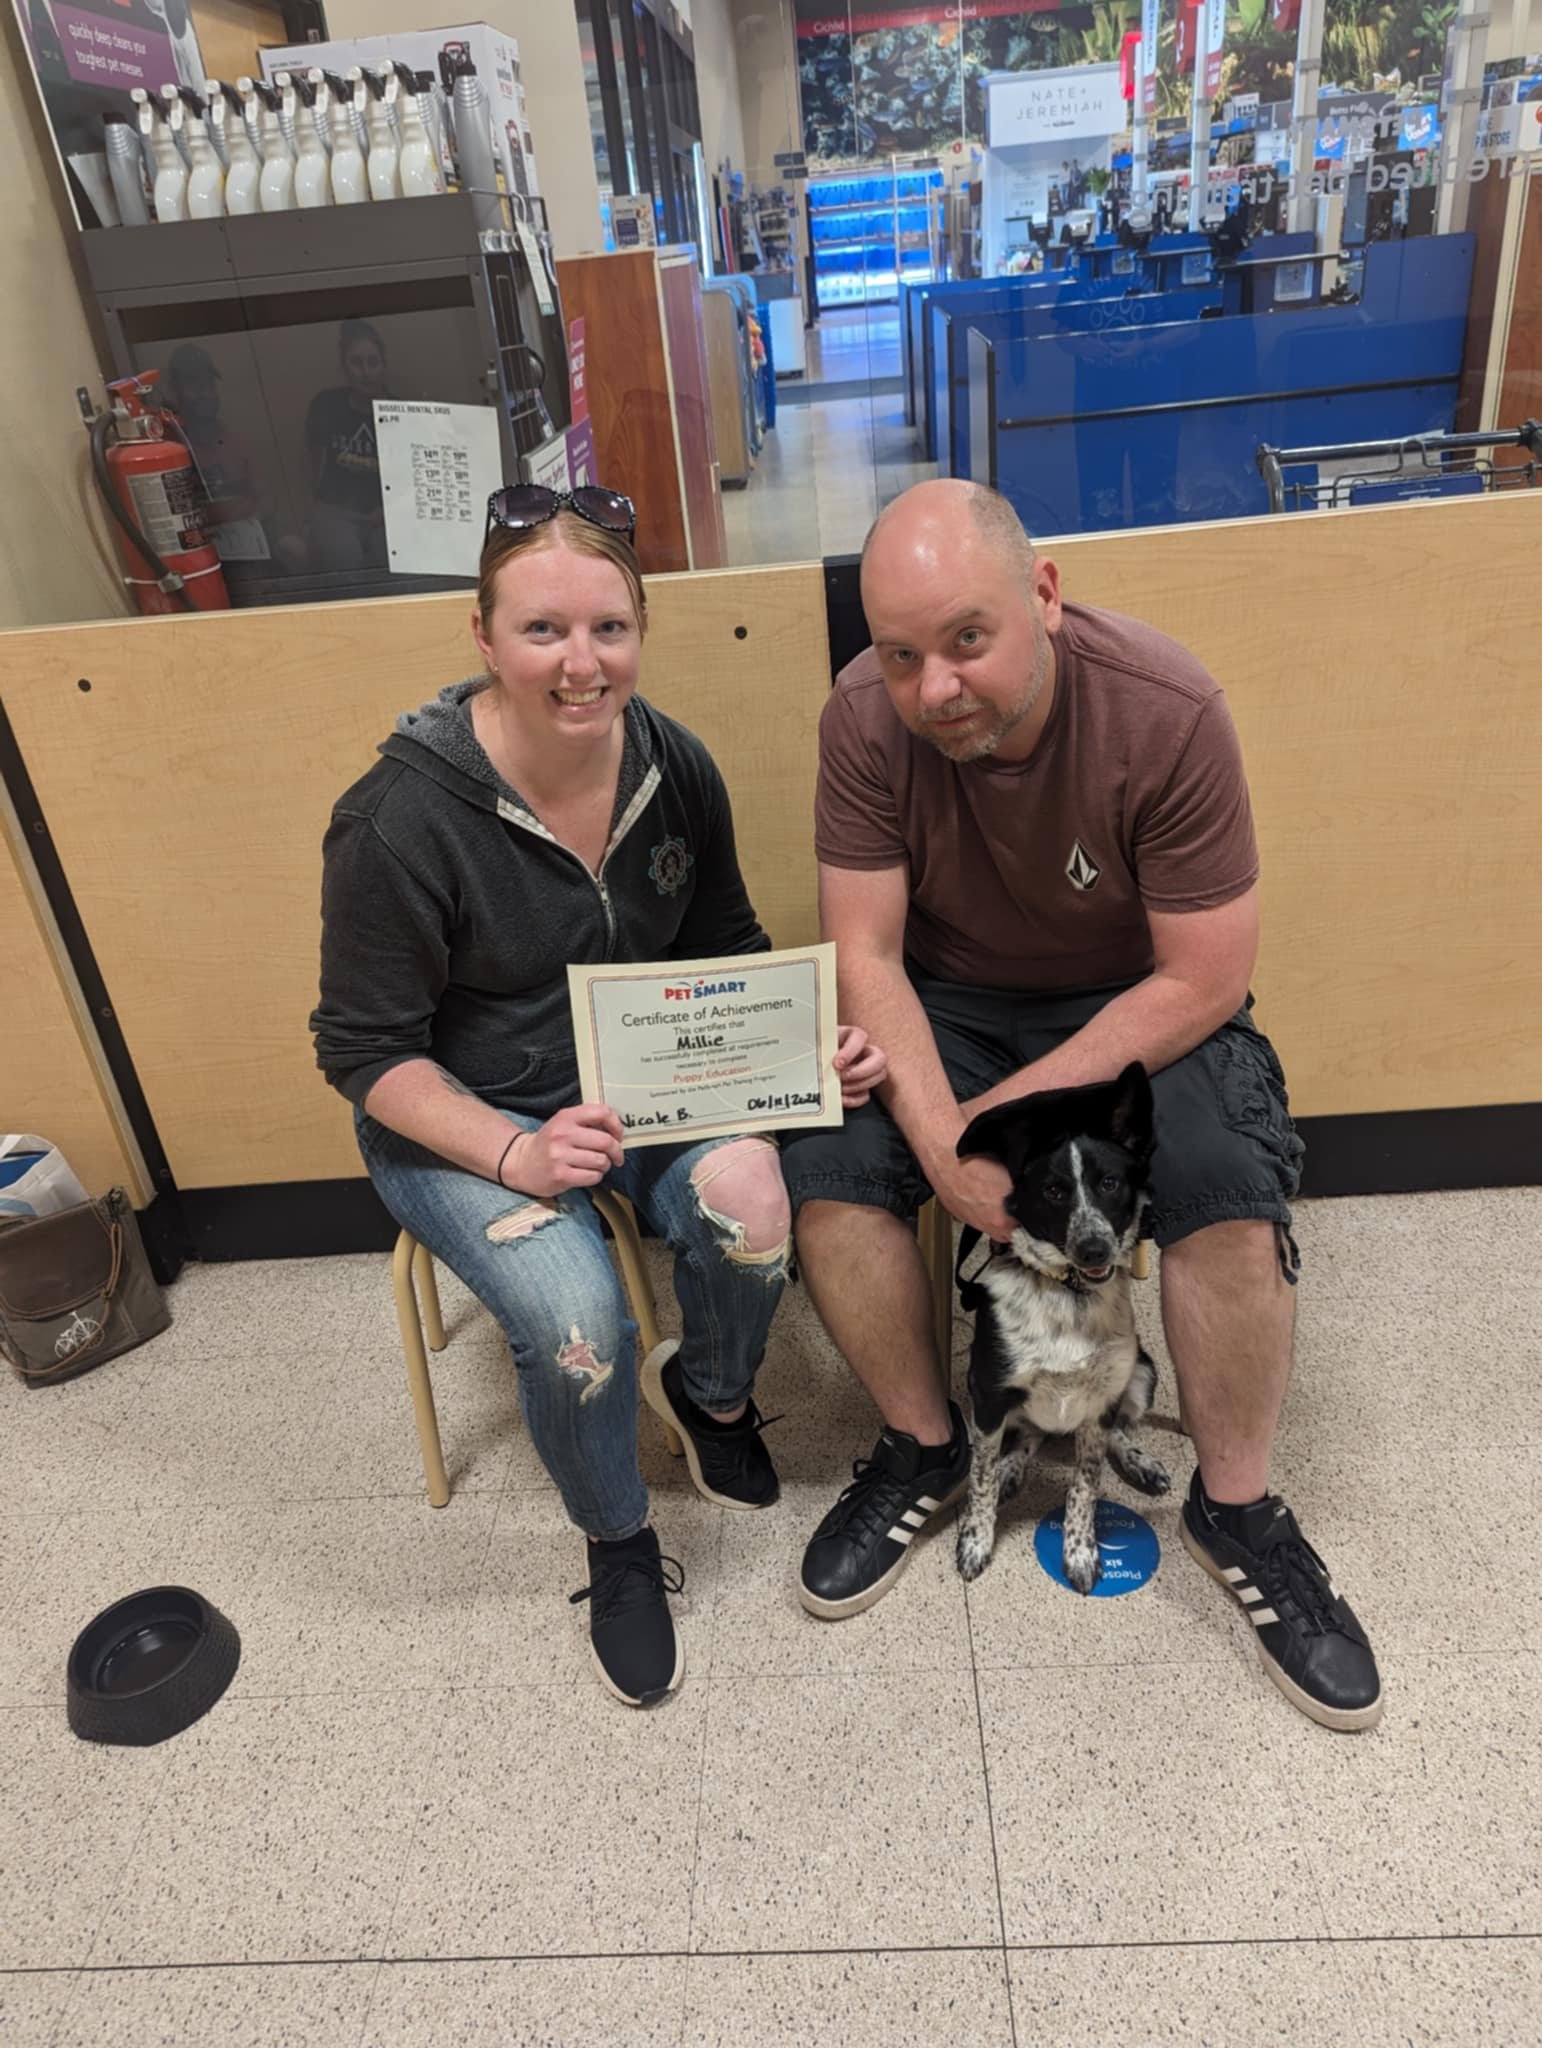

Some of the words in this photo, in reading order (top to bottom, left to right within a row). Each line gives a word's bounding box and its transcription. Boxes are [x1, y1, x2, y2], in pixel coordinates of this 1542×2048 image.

[68, 21, 94, 46] quickly
[94, 27, 112, 49] deep
[112, 31, 134, 53] cleans
[133, 41, 147, 56] your
[75, 50, 107, 70] toughest
[107, 58, 120, 75] pet
[120, 61, 144, 78] messes
[1016, 100, 1103, 121] JEREMIAH
[378, 404, 406, 413] BISSELL
[407, 405, 433, 415] RENTAL
[664, 980, 747, 1001] PETSMART
[621, 1010, 690, 1028] Certificate
[694, 1006, 707, 1021] of
[711, 998, 793, 1019] Achievement
[673, 1026, 691, 1036] This
[693, 1021, 727, 1034] certifies
[728, 1019, 745, 1029] that
[653, 1050, 690, 1063] successfully
[693, 1045, 727, 1057] completed
[738, 1038, 780, 1050] requirements
[676, 1034, 724, 1051] Millie
[717, 1054, 748, 1064] complete
[673, 1072, 703, 1084] Puppy
[705, 1064, 752, 1079] Education
[1105, 1558, 1123, 1567] six
